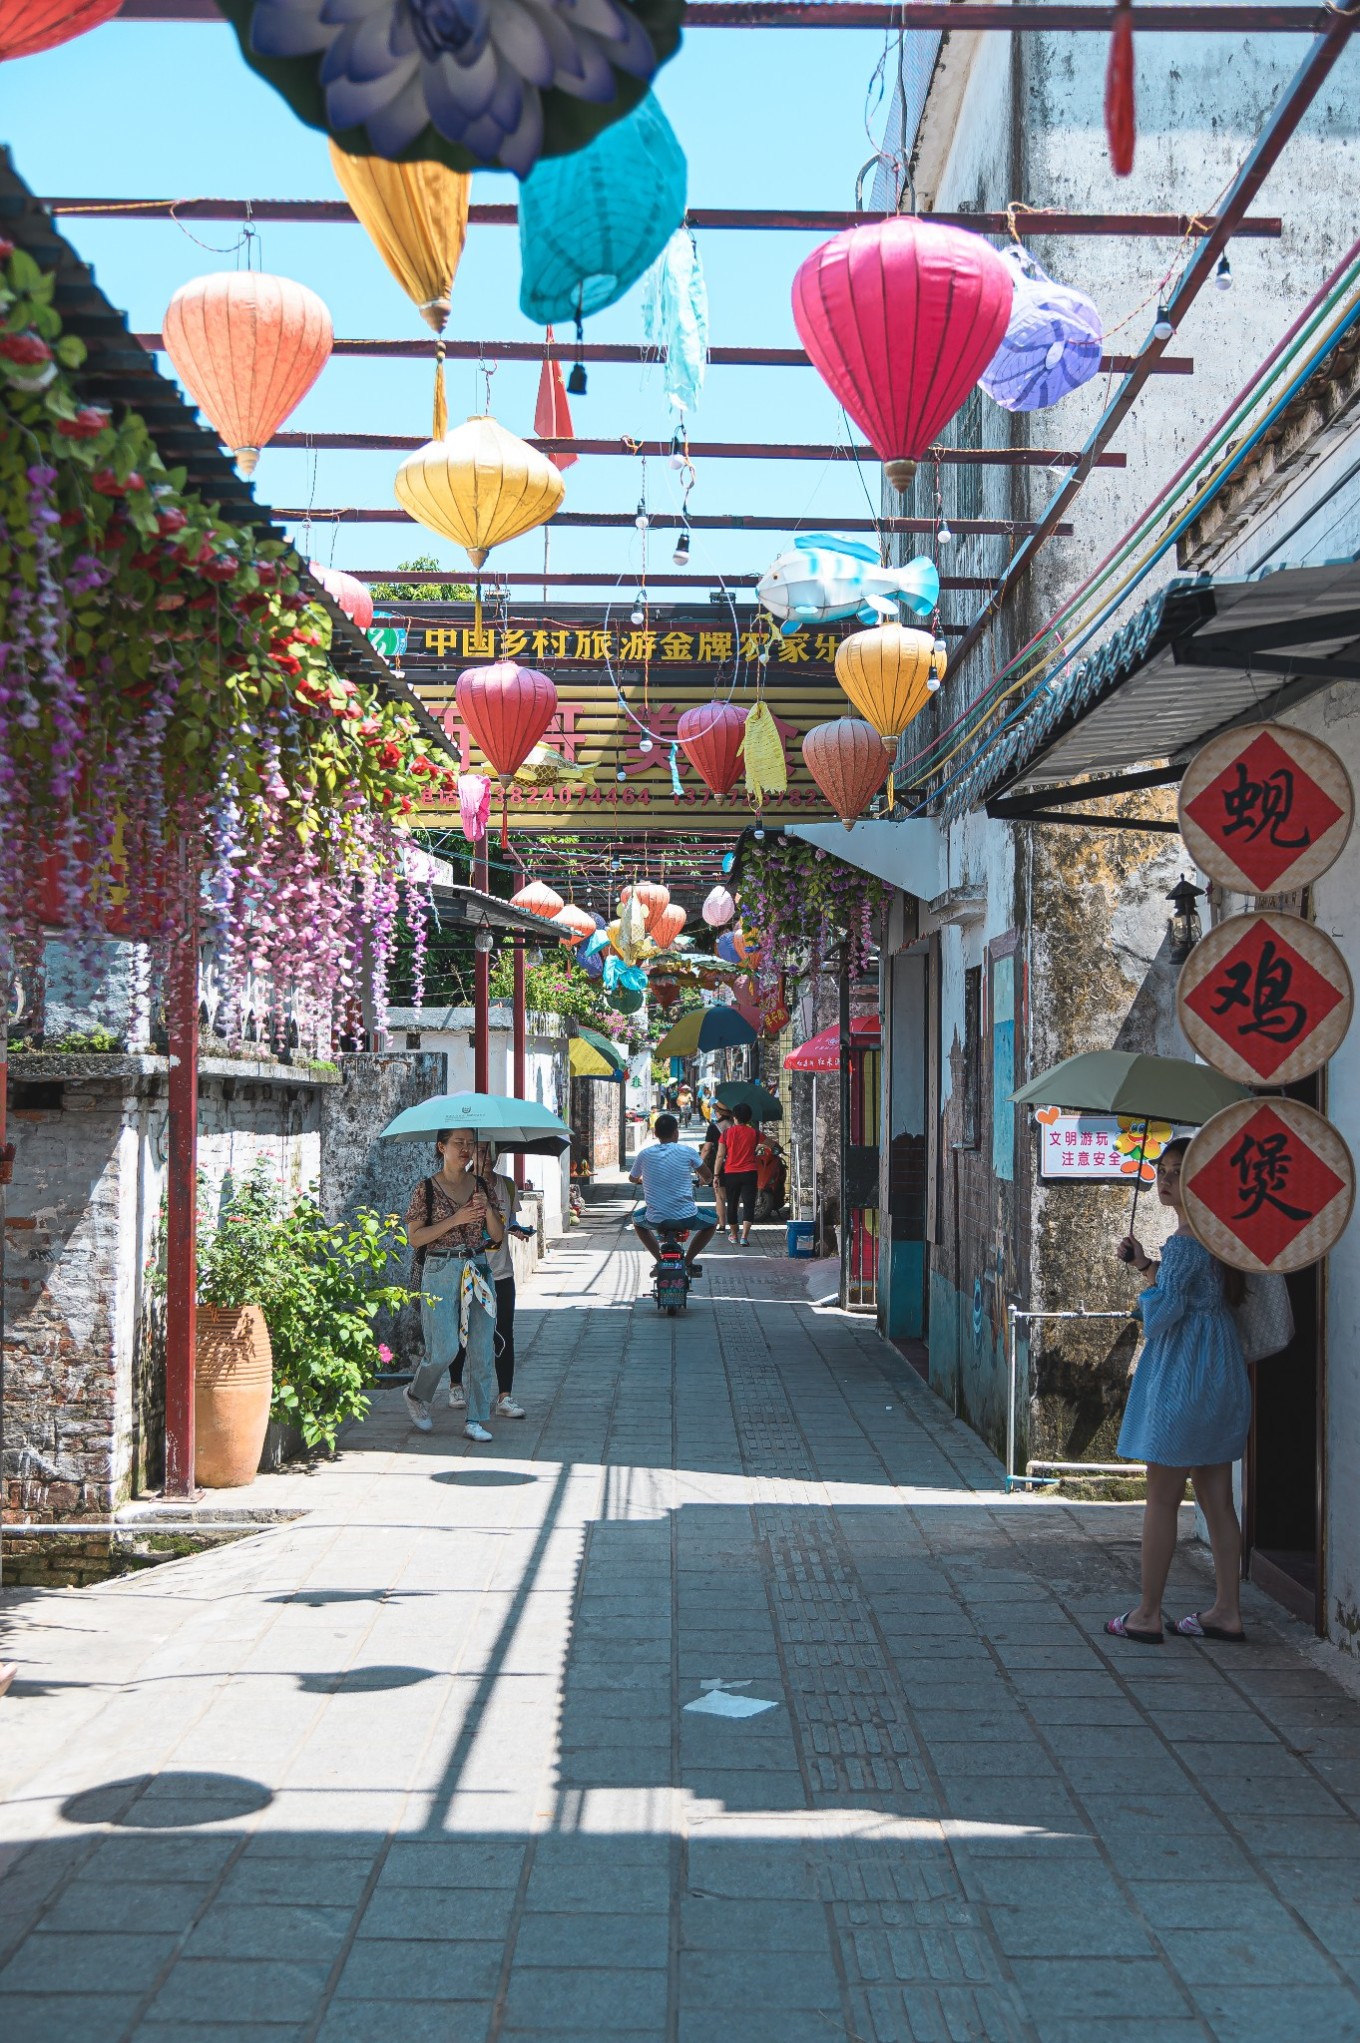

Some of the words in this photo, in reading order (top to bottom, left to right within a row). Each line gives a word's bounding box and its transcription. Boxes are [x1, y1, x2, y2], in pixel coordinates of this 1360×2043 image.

[493, 785, 650, 806] 3824074464
[1221, 763, 1311, 848] 蚬
[1211, 941, 1308, 1044] 鸡
[1049, 1130, 1109, 1146] 文明游玩
[1061, 1150, 1121, 1167] 注意安全
[1229, 1133, 1312, 1222] 煲
